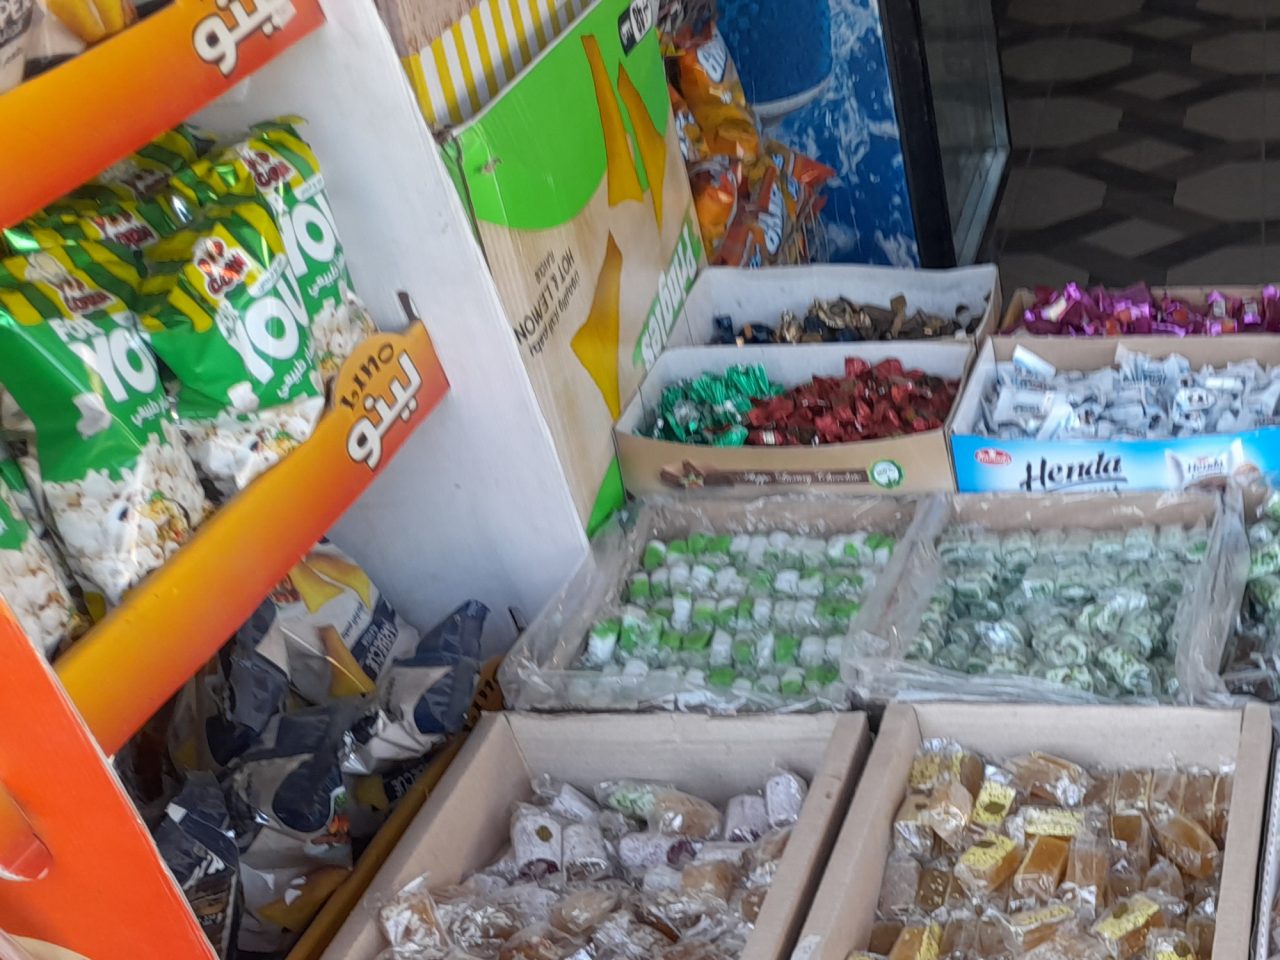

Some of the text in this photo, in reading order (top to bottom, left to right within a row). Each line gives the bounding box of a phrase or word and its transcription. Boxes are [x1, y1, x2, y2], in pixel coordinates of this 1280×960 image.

[192, 0, 296, 77] ينو
[346, 349, 423, 472] لينو
[1023, 451, 1122, 492] Henda
